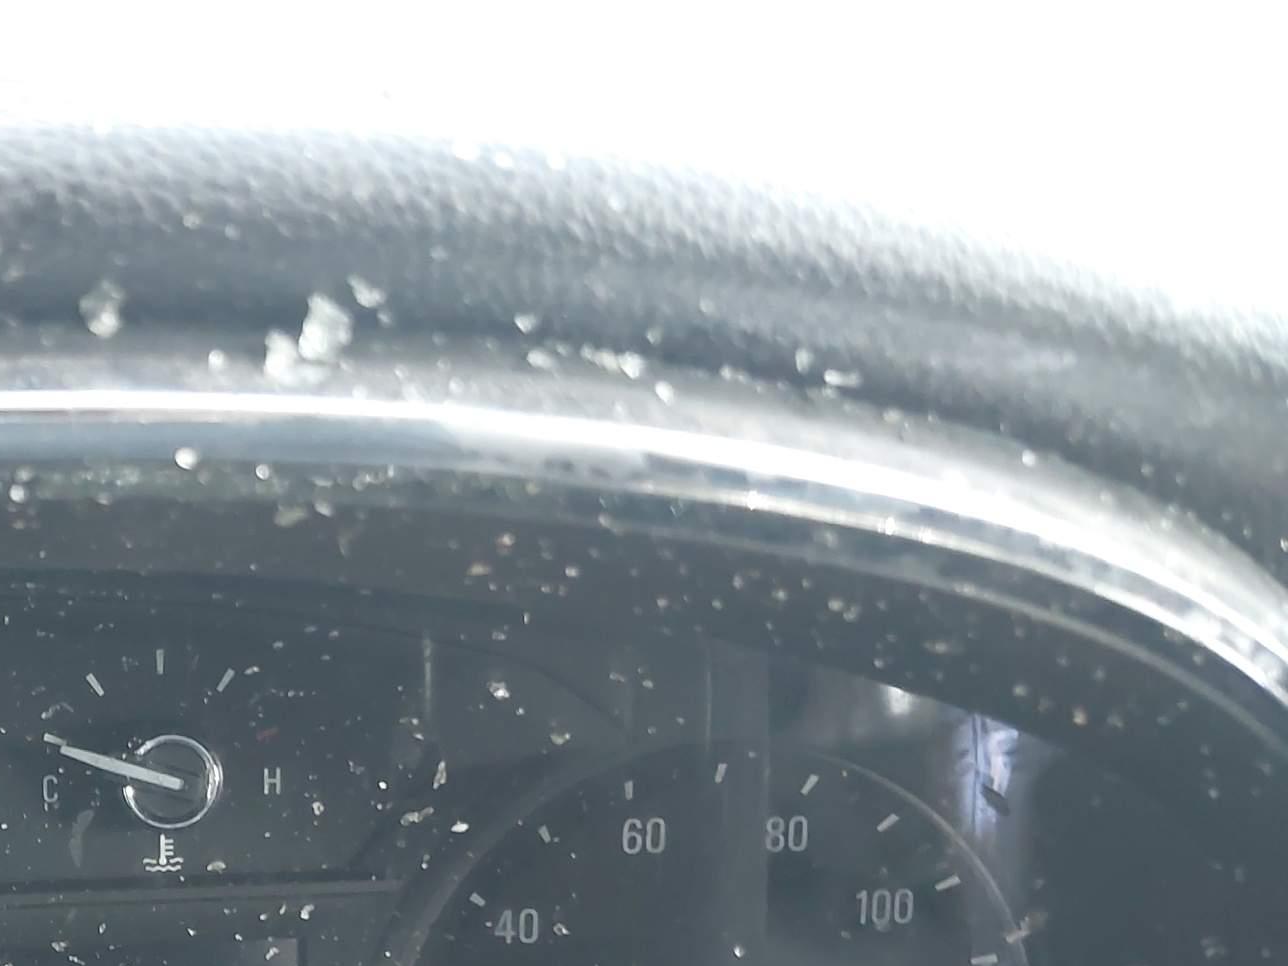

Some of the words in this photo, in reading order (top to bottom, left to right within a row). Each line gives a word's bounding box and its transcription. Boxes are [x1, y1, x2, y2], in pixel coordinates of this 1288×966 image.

[263, 769, 281, 796] H
[621, 818, 666, 854] 60
[765, 818, 809, 853] 80
[856, 890, 914, 925] 100
[494, 910, 539, 944] 40
